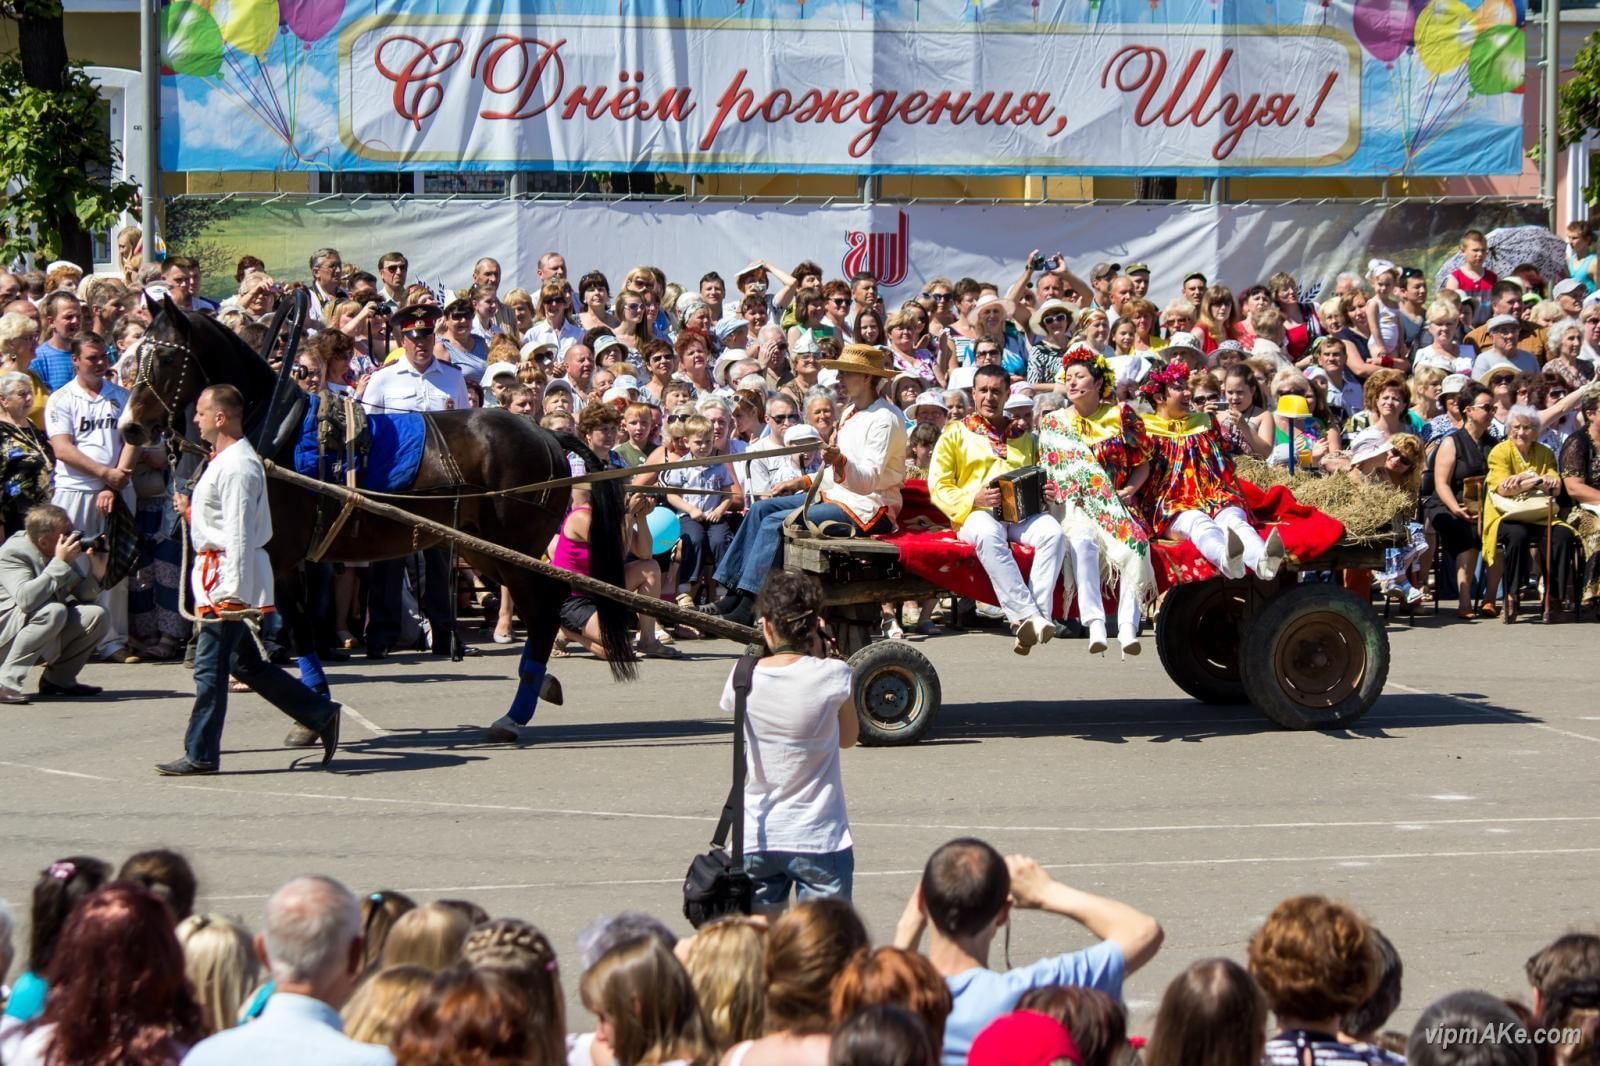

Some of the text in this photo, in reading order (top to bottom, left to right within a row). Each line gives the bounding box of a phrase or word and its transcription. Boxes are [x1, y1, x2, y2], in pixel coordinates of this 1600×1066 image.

[374, 34, 1340, 161] С Днём рождения, Шуя!
